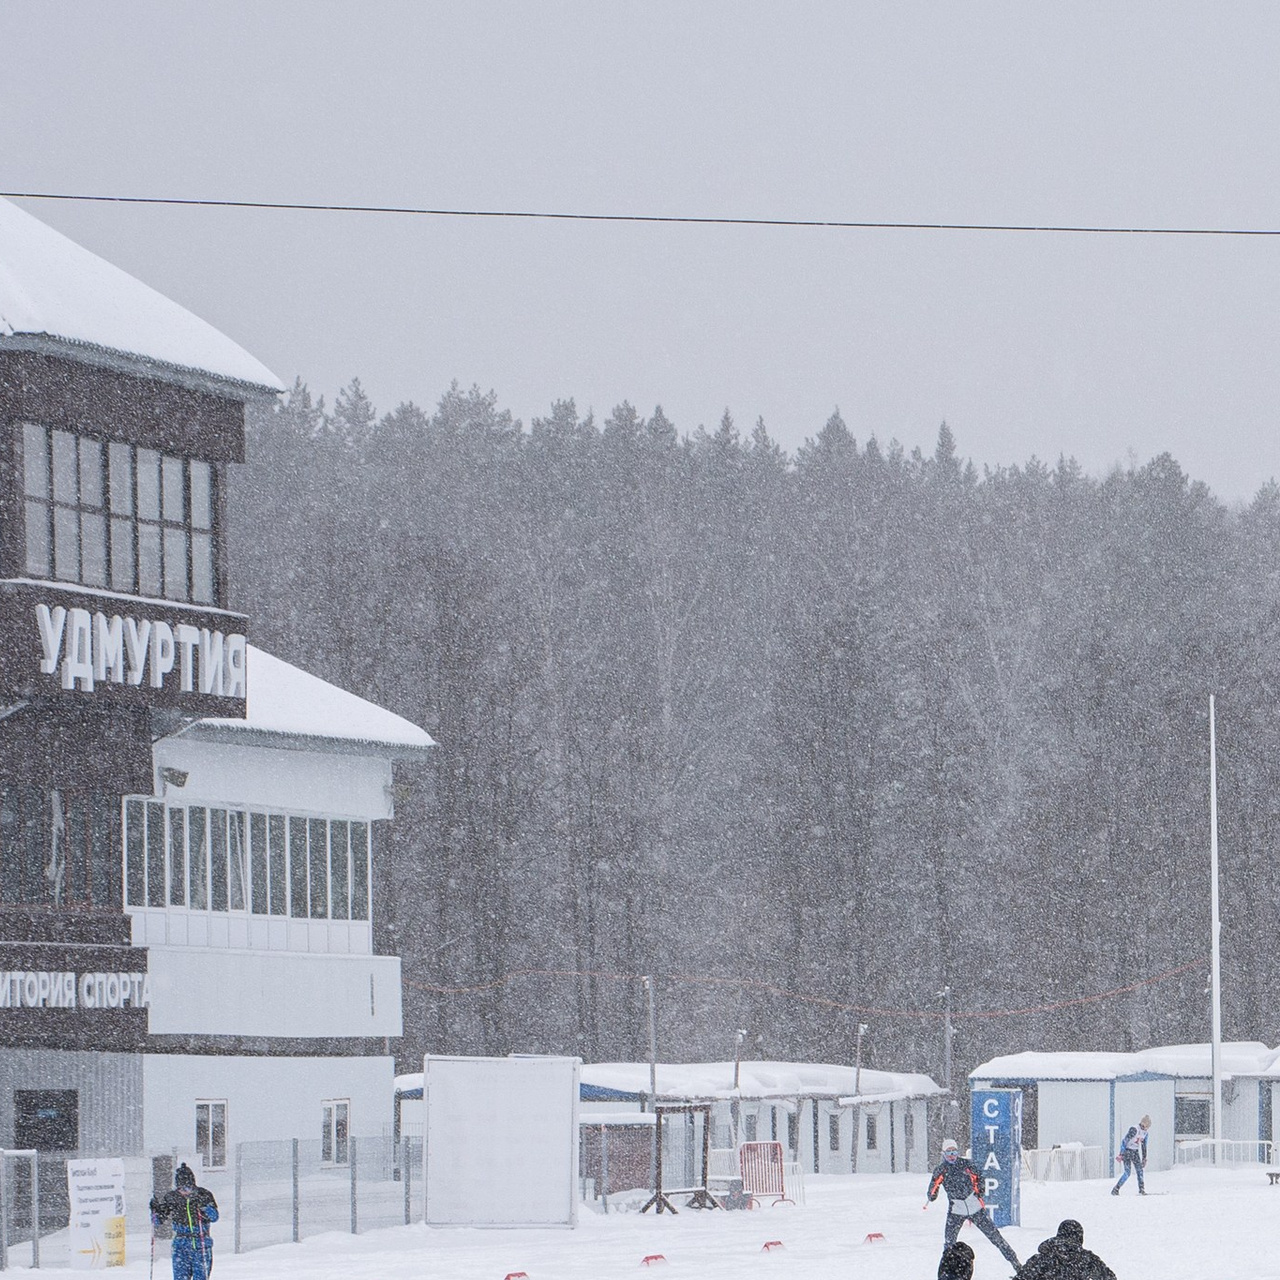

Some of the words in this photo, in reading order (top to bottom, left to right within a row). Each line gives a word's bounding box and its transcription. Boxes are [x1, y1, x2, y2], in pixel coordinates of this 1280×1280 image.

[35, 603, 246, 698] УДМУРТИЯ
[79, 972, 150, 1009] СПОРТА
[984, 1098, 1001, 1222] СТАРТ
